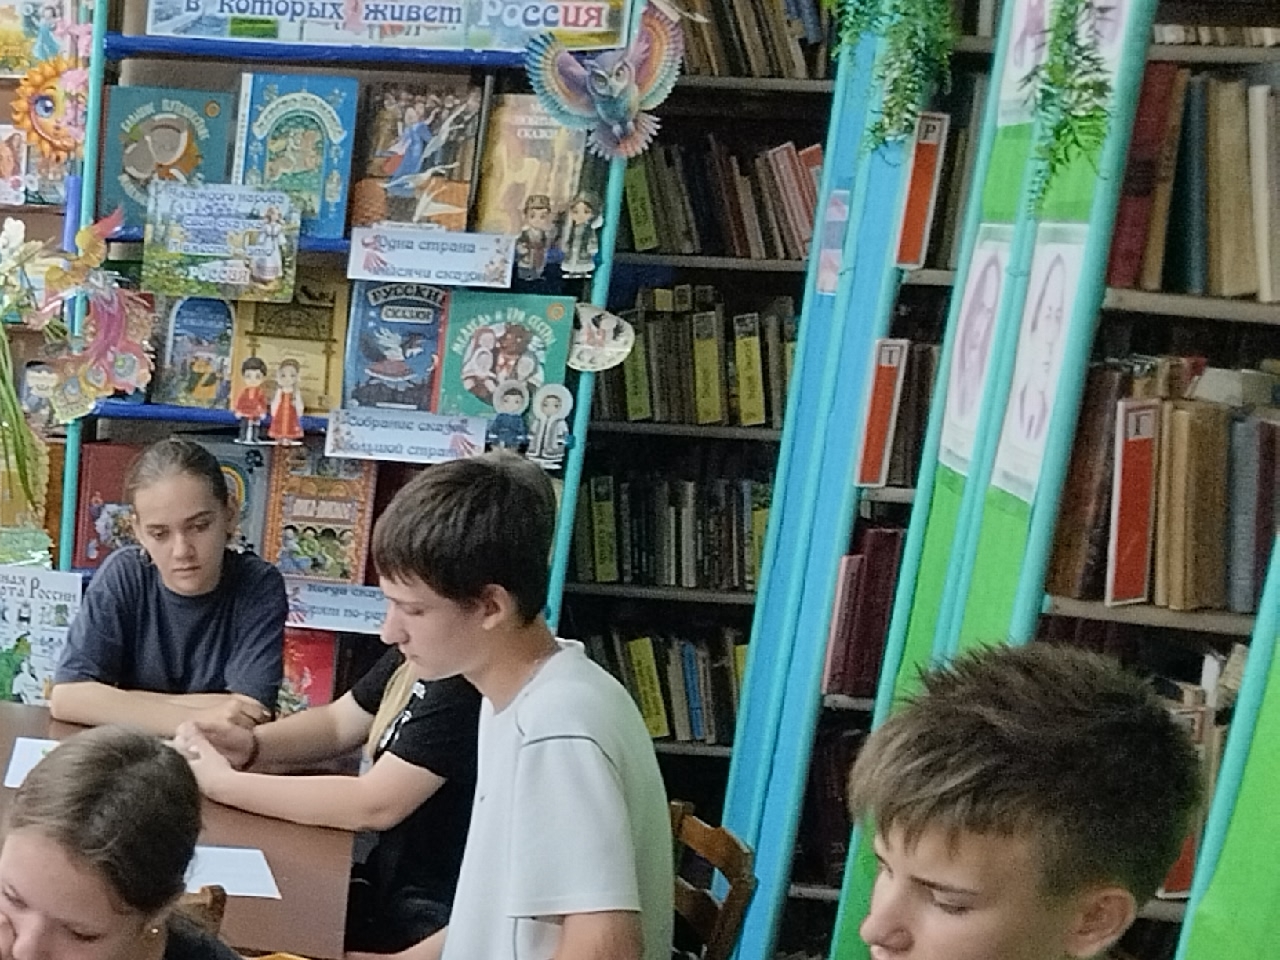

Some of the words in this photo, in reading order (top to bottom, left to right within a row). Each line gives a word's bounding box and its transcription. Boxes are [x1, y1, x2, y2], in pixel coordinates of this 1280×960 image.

[219, 0, 344, 22] которых
[364, 4, 462, 24] живет
[478, 0, 603, 27] Россия
[418, 240, 476, 254] страна
